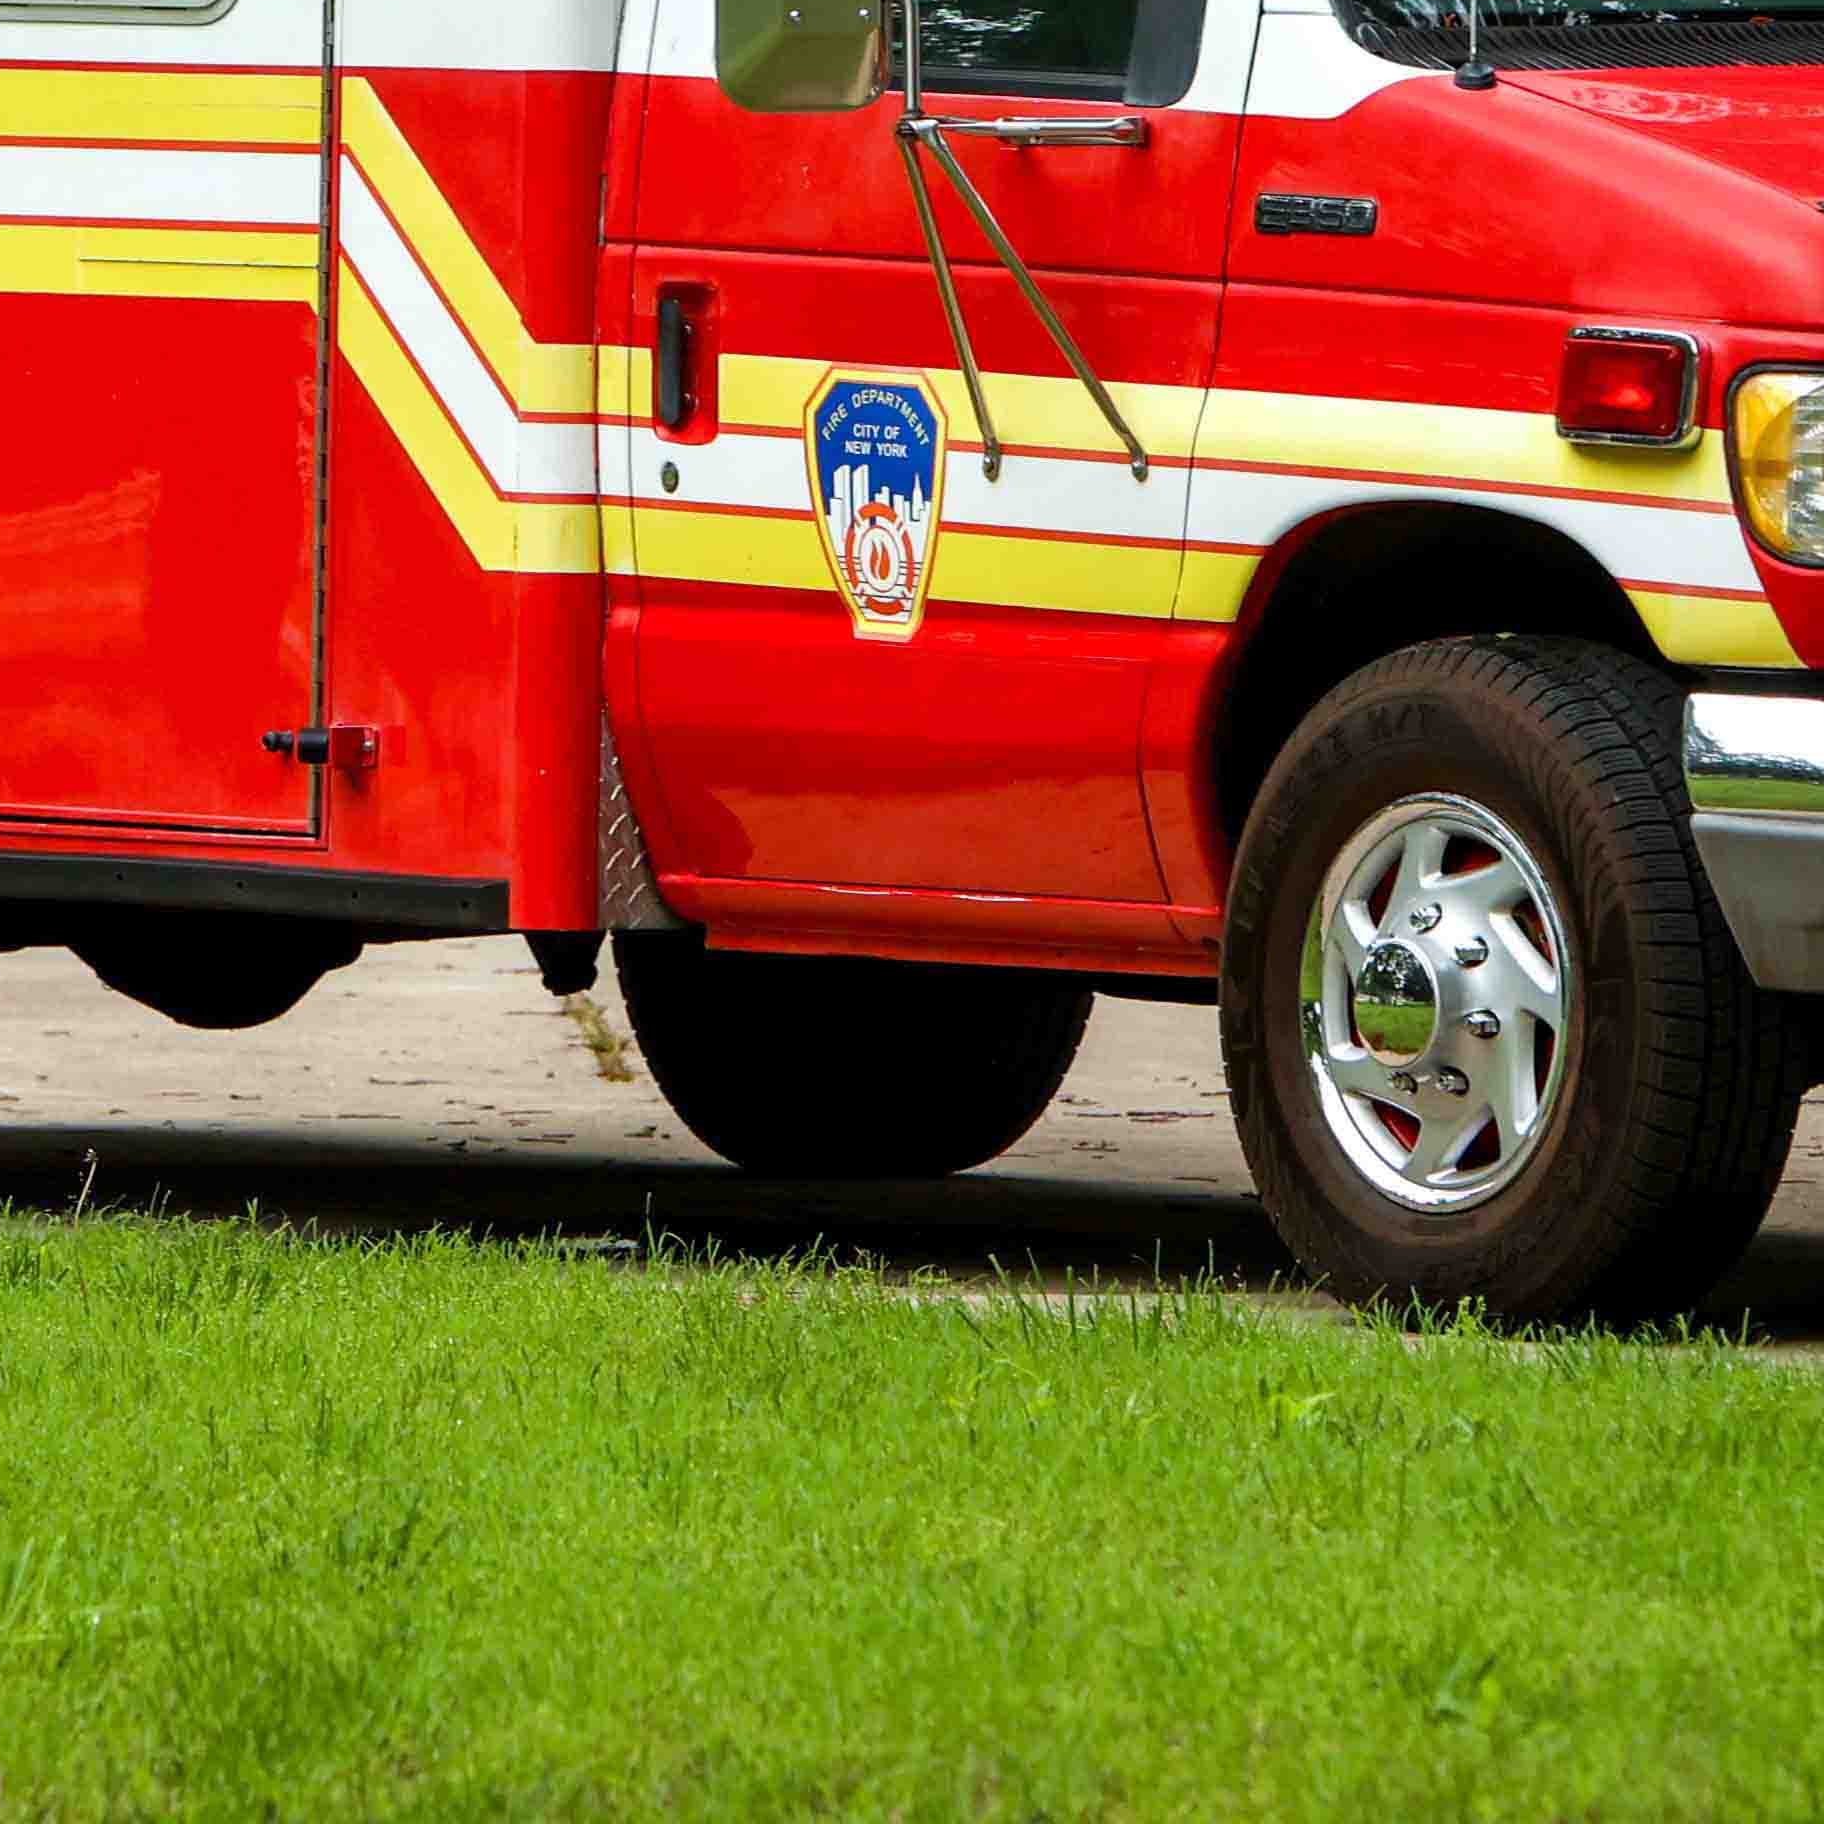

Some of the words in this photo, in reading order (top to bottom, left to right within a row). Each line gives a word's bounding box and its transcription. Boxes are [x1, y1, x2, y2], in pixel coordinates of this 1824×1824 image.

[821, 402, 848, 441] FIRE
[851, 389, 930, 445] DEPARTMENT
[853, 423, 881, 439] CITY
[884, 426, 901, 440] OF
[844, 439, 872, 455] NEW
[875, 441, 908, 458] YORK
